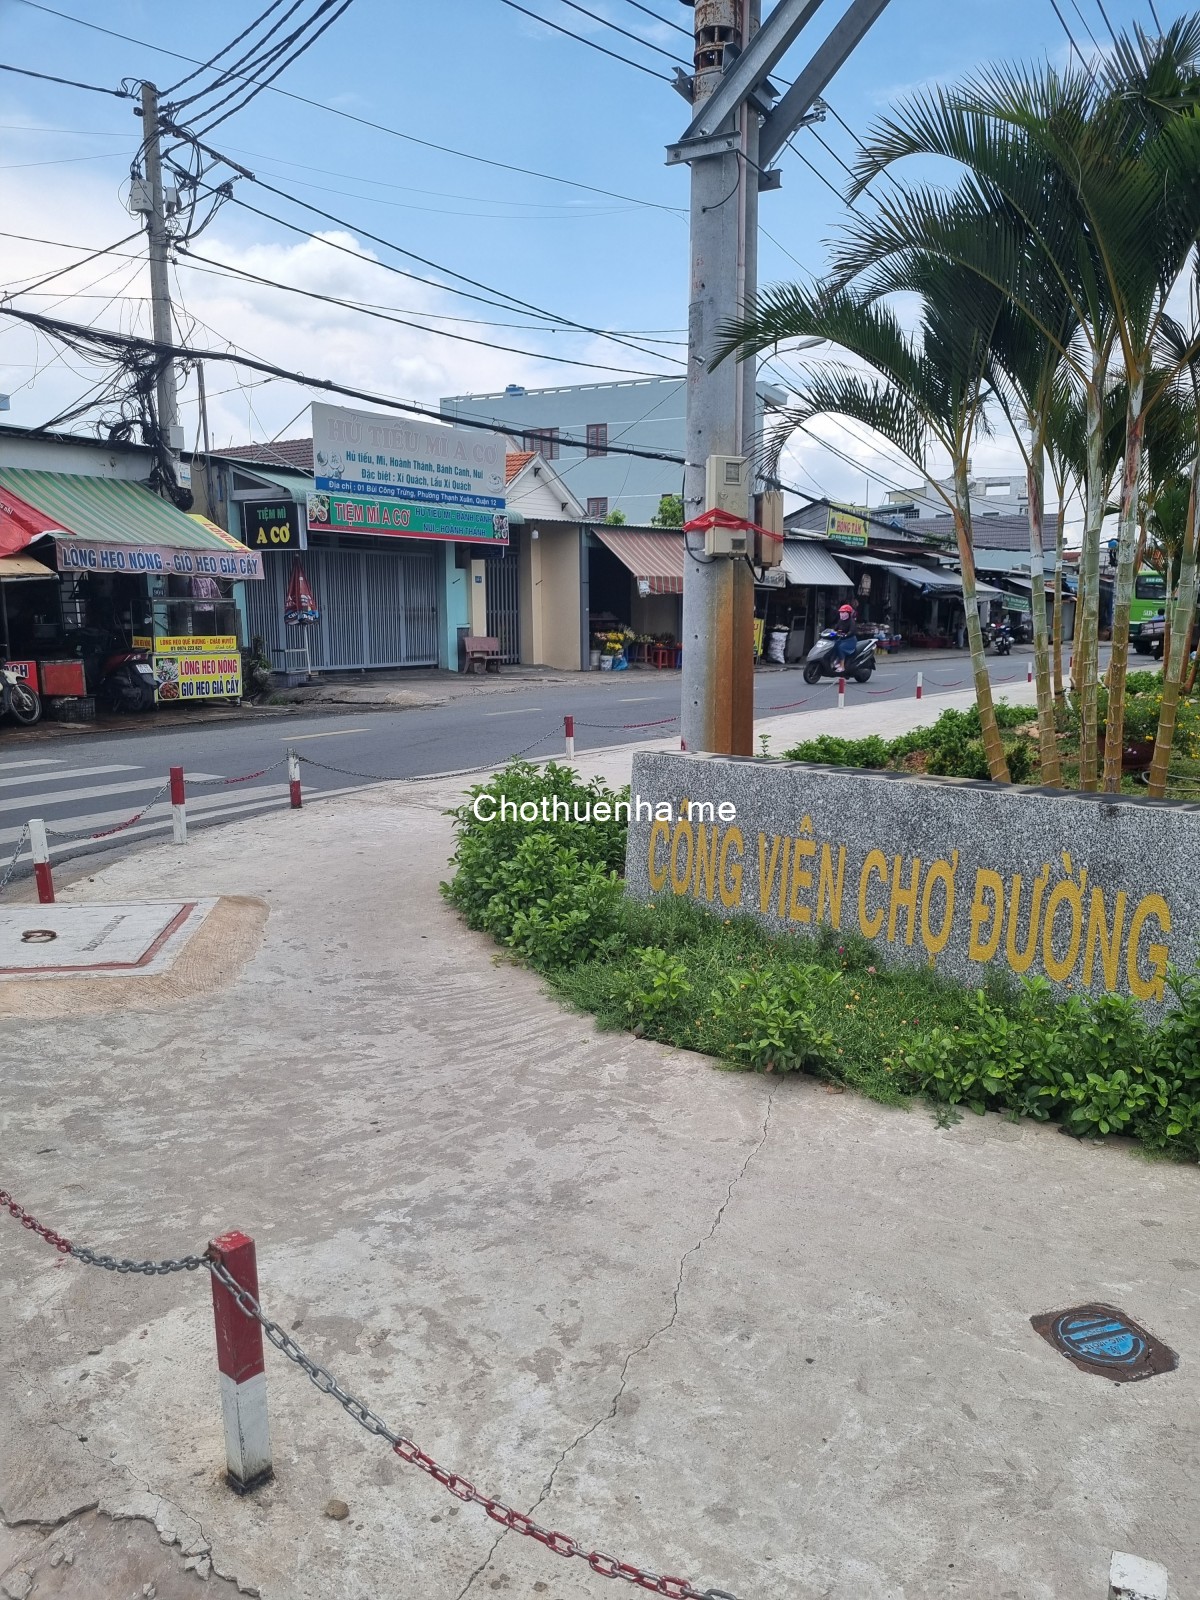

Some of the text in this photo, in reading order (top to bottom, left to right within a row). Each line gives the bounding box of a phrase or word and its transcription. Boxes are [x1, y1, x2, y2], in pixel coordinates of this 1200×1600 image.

[453, 440, 468, 461] A
[362, 468, 376, 482] Đặc
[378, 470, 391, 484] biệt
[452, 480, 472, 492] Quách
[436, 464, 452, 475] Bánh
[454, 466, 472, 478] Canh,
[473, 469, 484, 480] Nui
[328, 480, 340, 489] Địa
[357, 484, 365, 492] 01
[366, 484, 377, 493] Bùi
[378, 486, 395, 496] Công
[441, 493, 459, 503] Thạnh
[476, 498, 490, 507] Quận
[257, 506, 286, 521] TIỆM MÌ
[334, 500, 410, 527] TIỆM MÌ A CƠ
[256, 526, 268, 544] A
[270, 522, 290, 544] CƠ
[62, 544, 97, 568] LÒNG
[100, 552, 125, 569] HEO
[128, 548, 163, 570] NÓNG
[174, 552, 193, 572] GIÒ
[195, 555, 218, 573] HEO
[220, 554, 238, 574] GIẢ
[180, 656, 237, 676] LÒNG HEO NÓNG
[182, 678, 194, 696] GIÒ
[196, 681, 210, 695] HEO
[212, 676, 224, 694] GIẢ
[650, 797, 1172, 1002] CÔNG VIÊN CHỢ ĐƯỜNG
